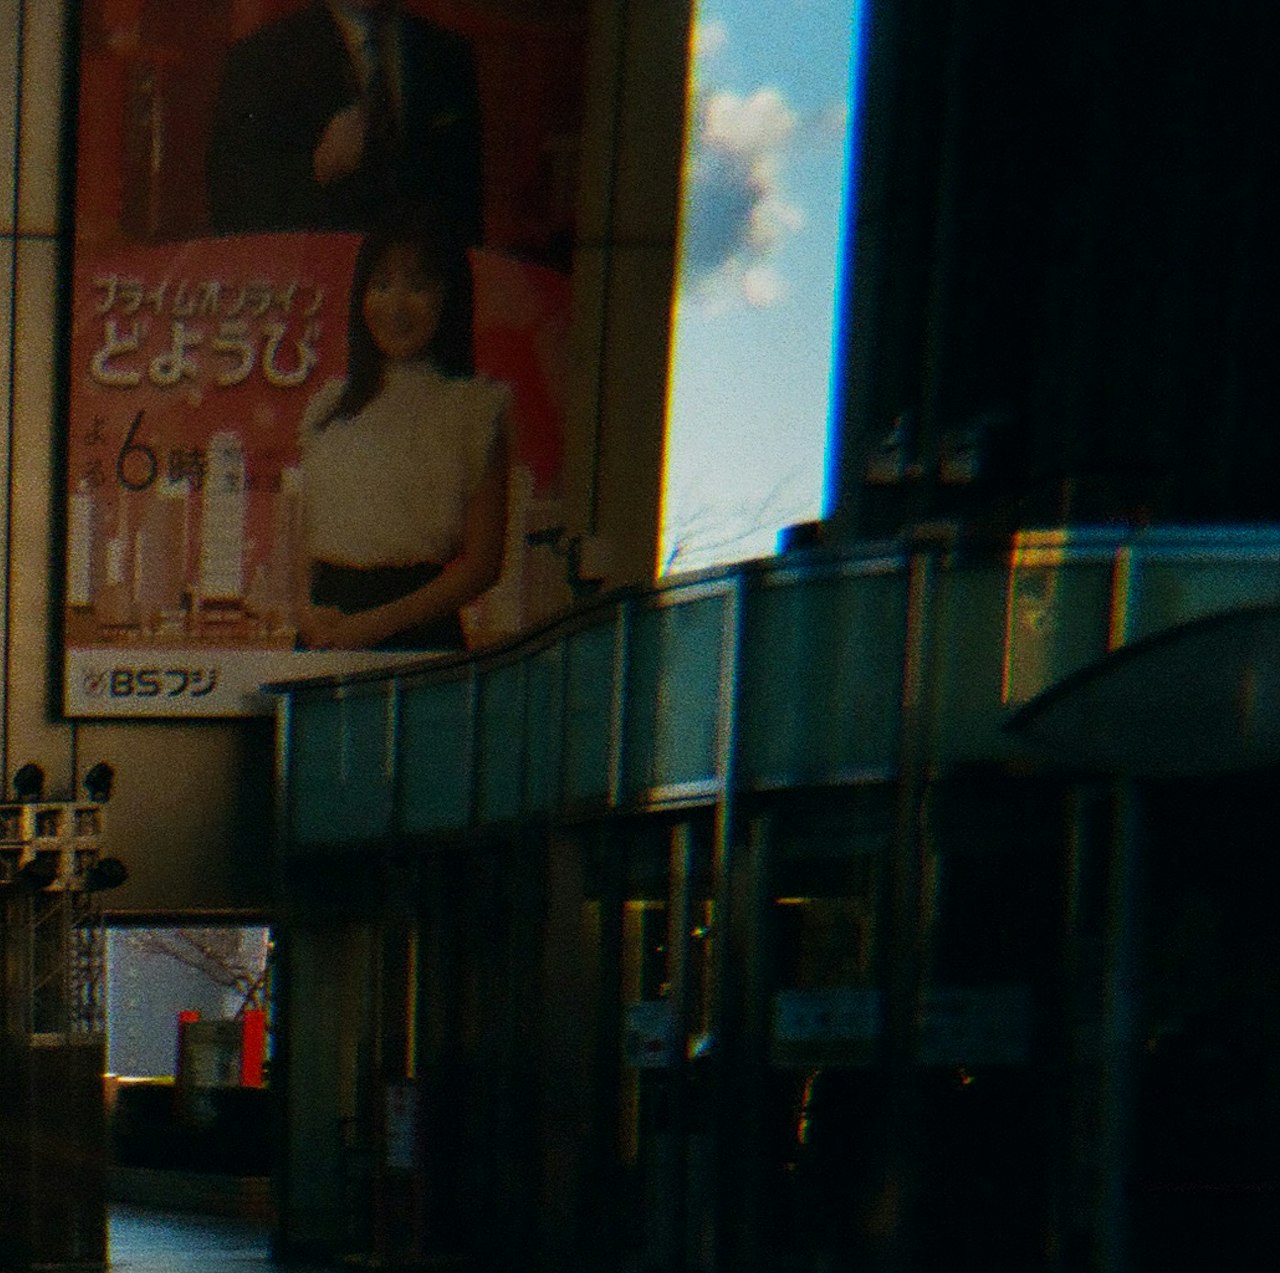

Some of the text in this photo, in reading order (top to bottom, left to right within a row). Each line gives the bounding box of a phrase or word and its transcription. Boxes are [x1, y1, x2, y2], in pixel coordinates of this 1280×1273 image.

[92, 319, 321, 388] どようび
[111, 668, 218, 698] BSフジ
